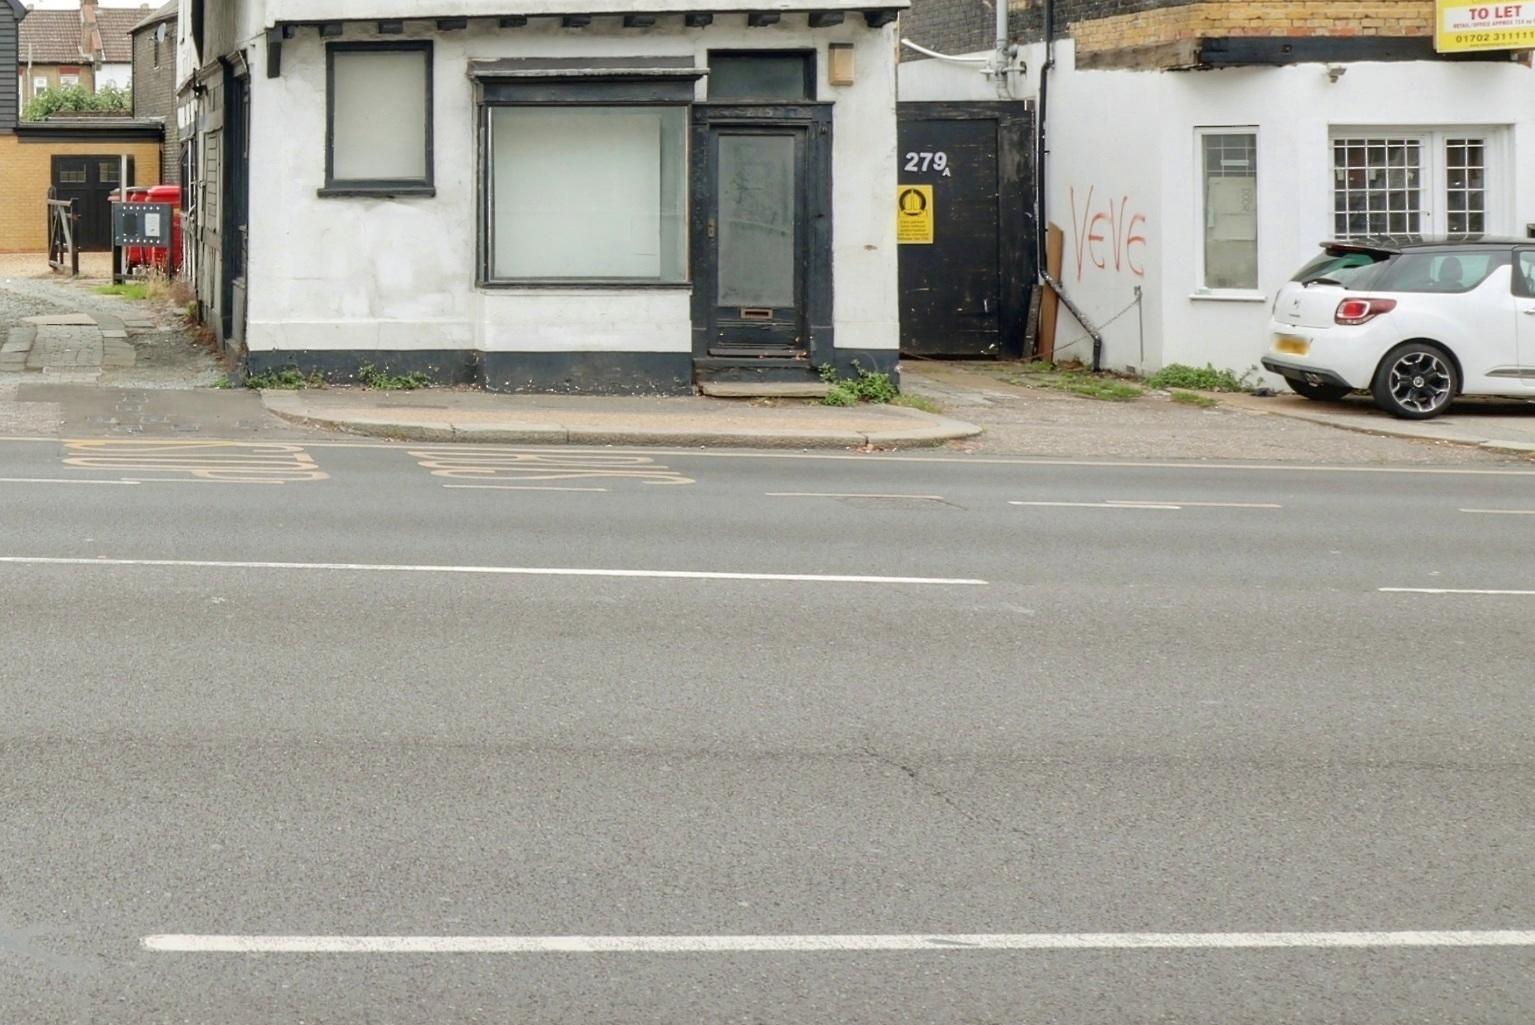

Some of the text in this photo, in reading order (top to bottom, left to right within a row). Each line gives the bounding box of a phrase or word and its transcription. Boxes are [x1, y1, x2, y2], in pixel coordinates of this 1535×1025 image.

[1469, 5, 1522, 20] TO LET
[1455, 33, 1490, 44] 01702
[62, 439, 330, 481] STOP
[407, 451, 696, 486] BUS
